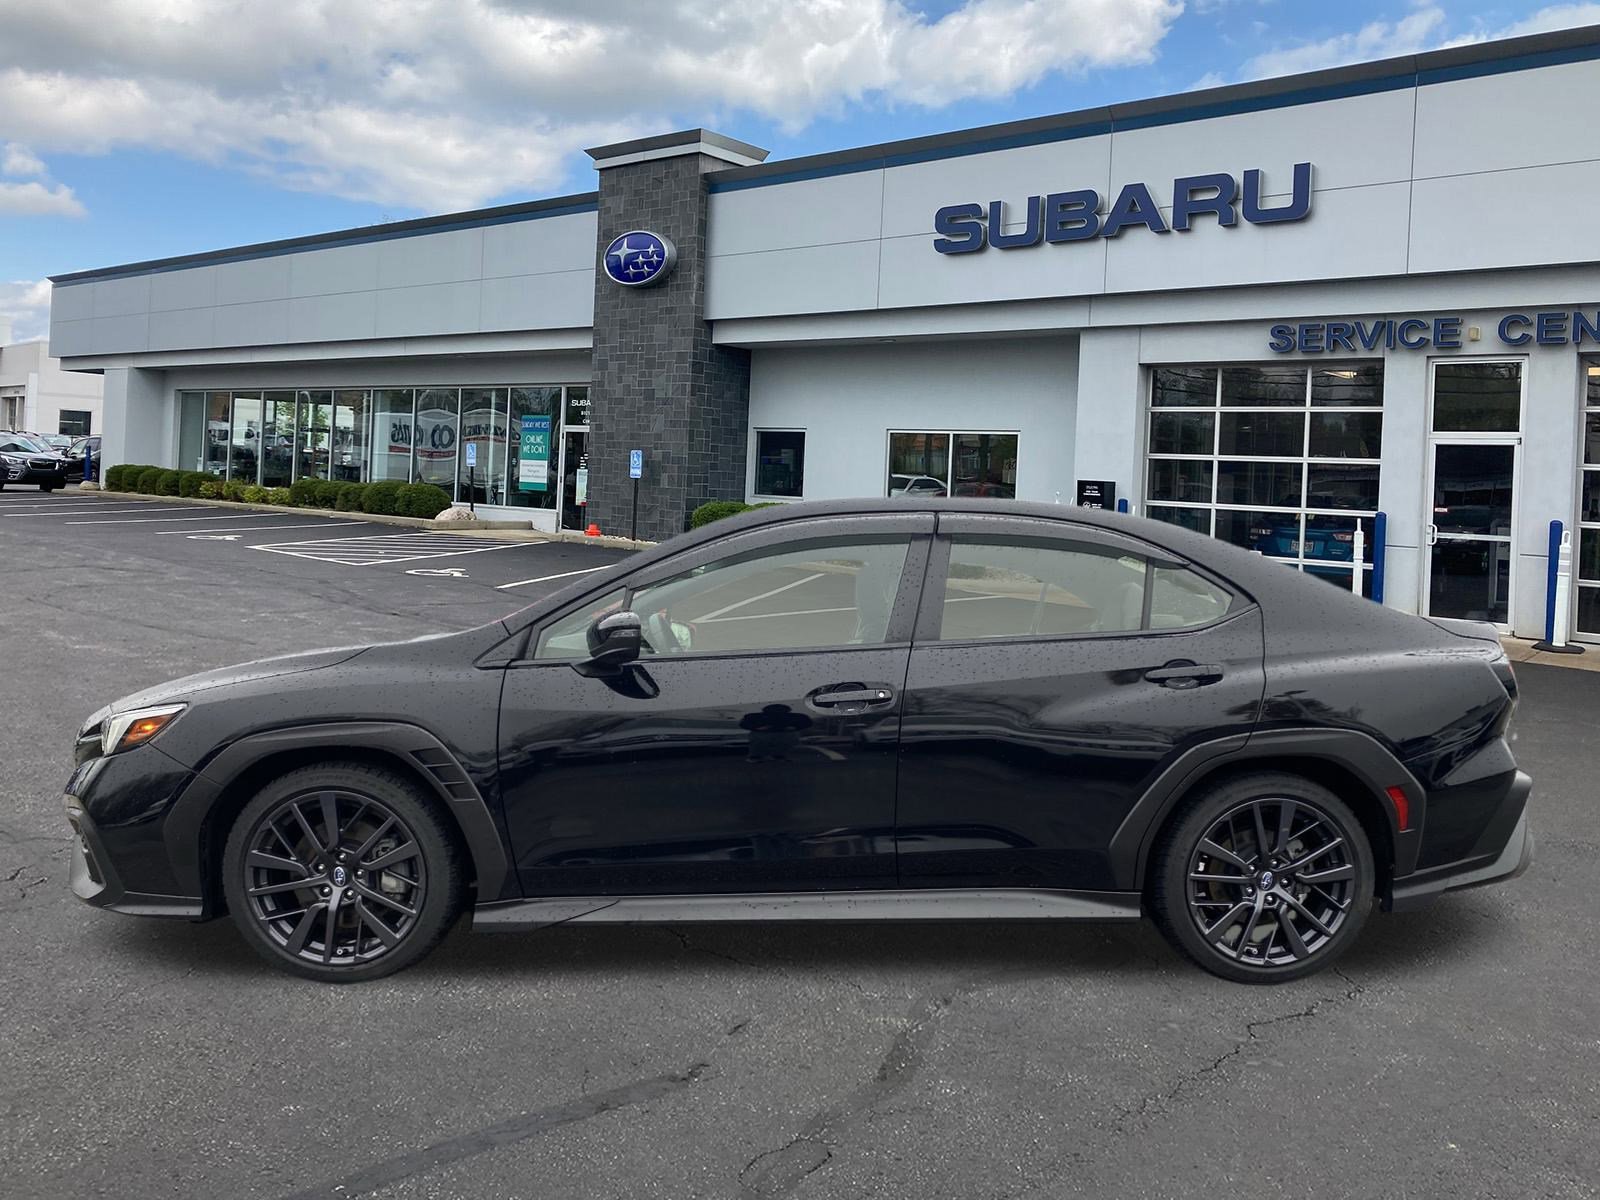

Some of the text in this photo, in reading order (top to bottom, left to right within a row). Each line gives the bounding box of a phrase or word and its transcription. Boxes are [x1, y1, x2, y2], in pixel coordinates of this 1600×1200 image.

[934, 162, 1312, 255] SUBARU
[1268, 310, 1600, 352] SERVICE CEN
